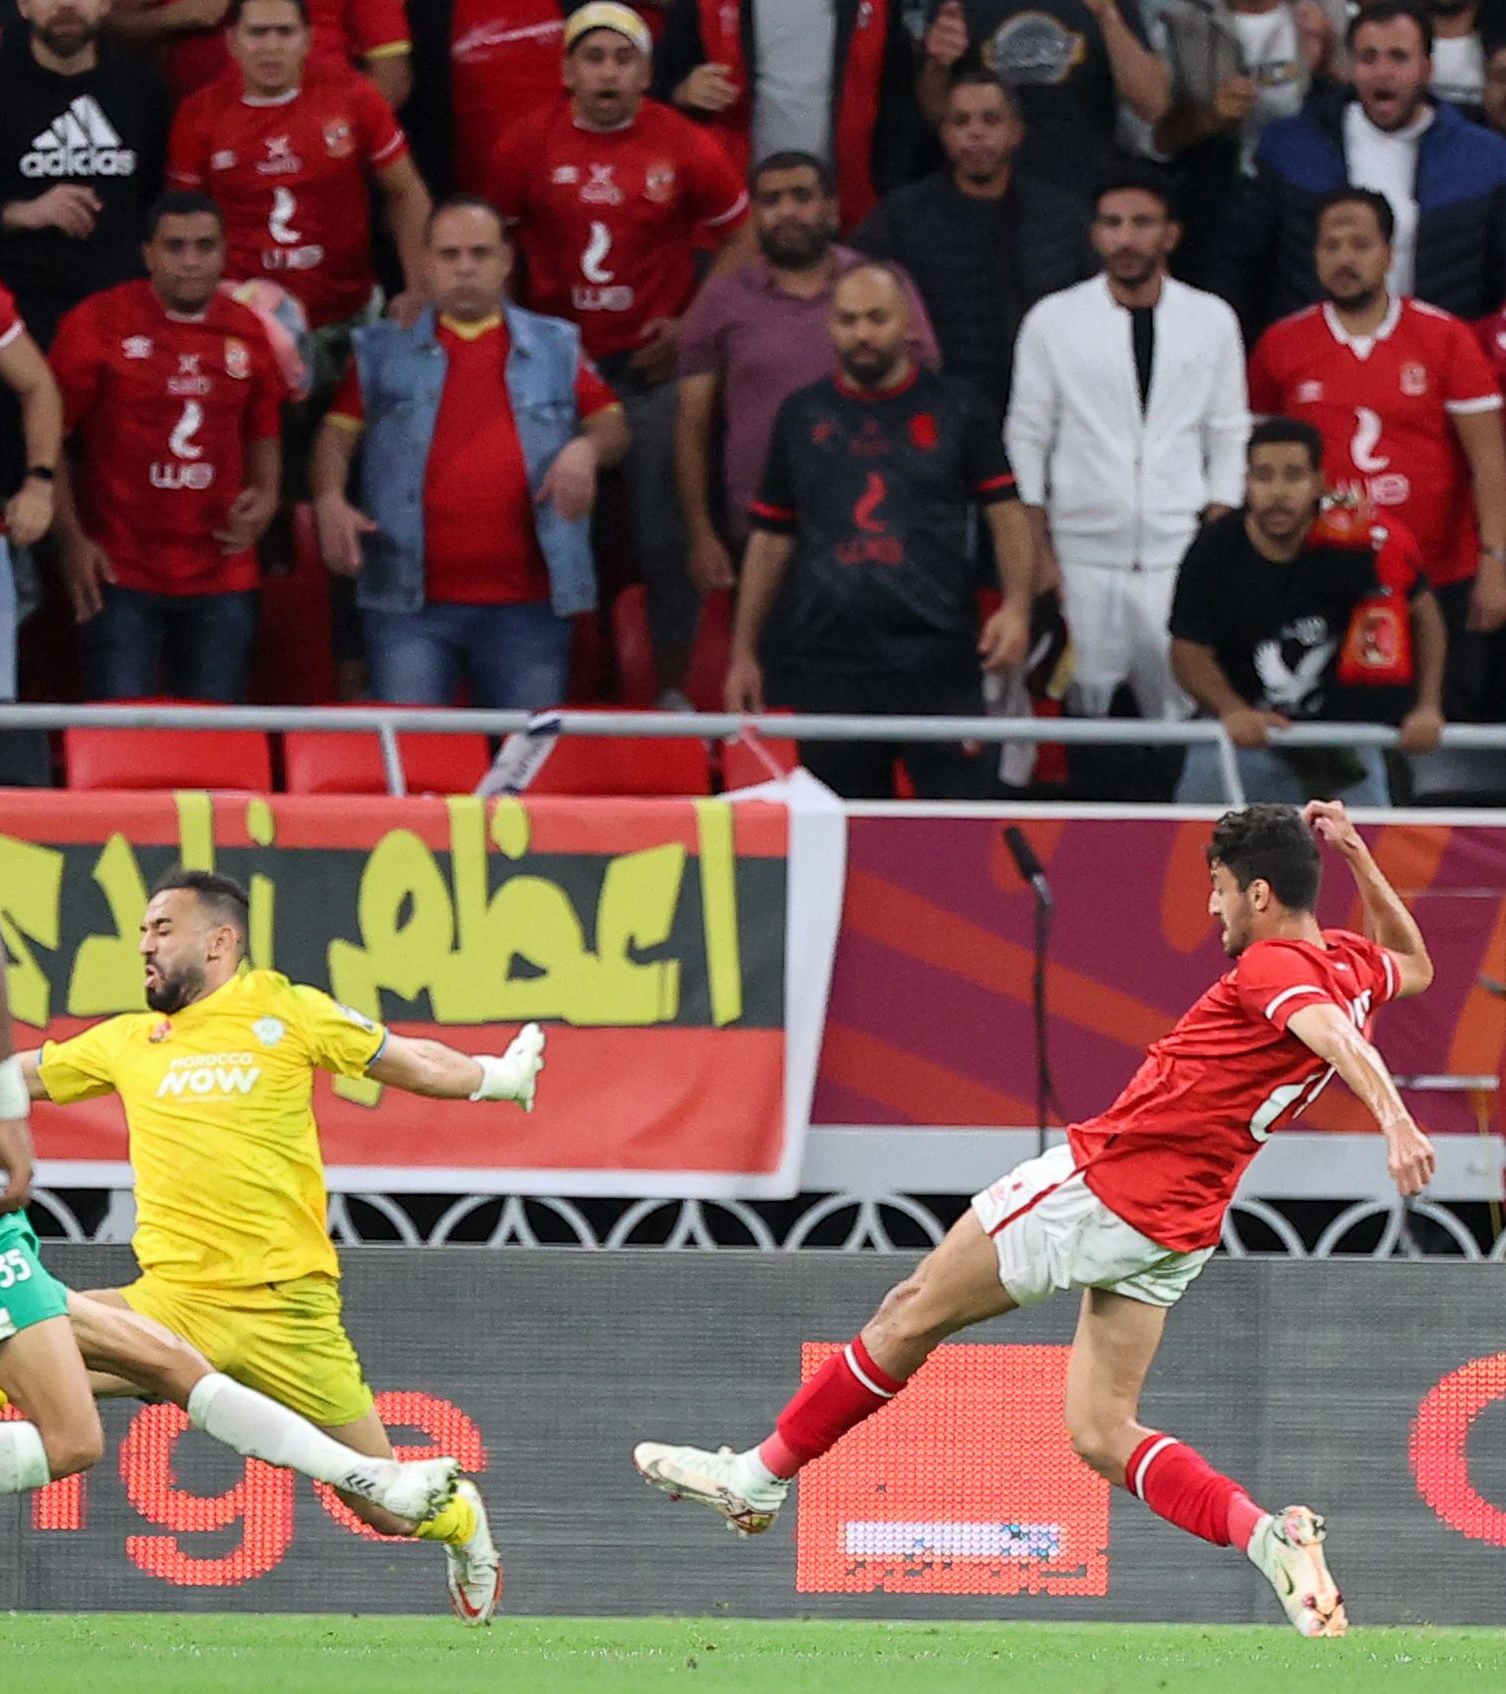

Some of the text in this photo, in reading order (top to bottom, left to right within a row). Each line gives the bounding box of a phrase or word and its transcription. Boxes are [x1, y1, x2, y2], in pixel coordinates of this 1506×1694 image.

[19, 147, 137, 179] adidas
[171, 1052, 254, 1069] MOROCCO
[155, 1067, 261, 1098] NOW
